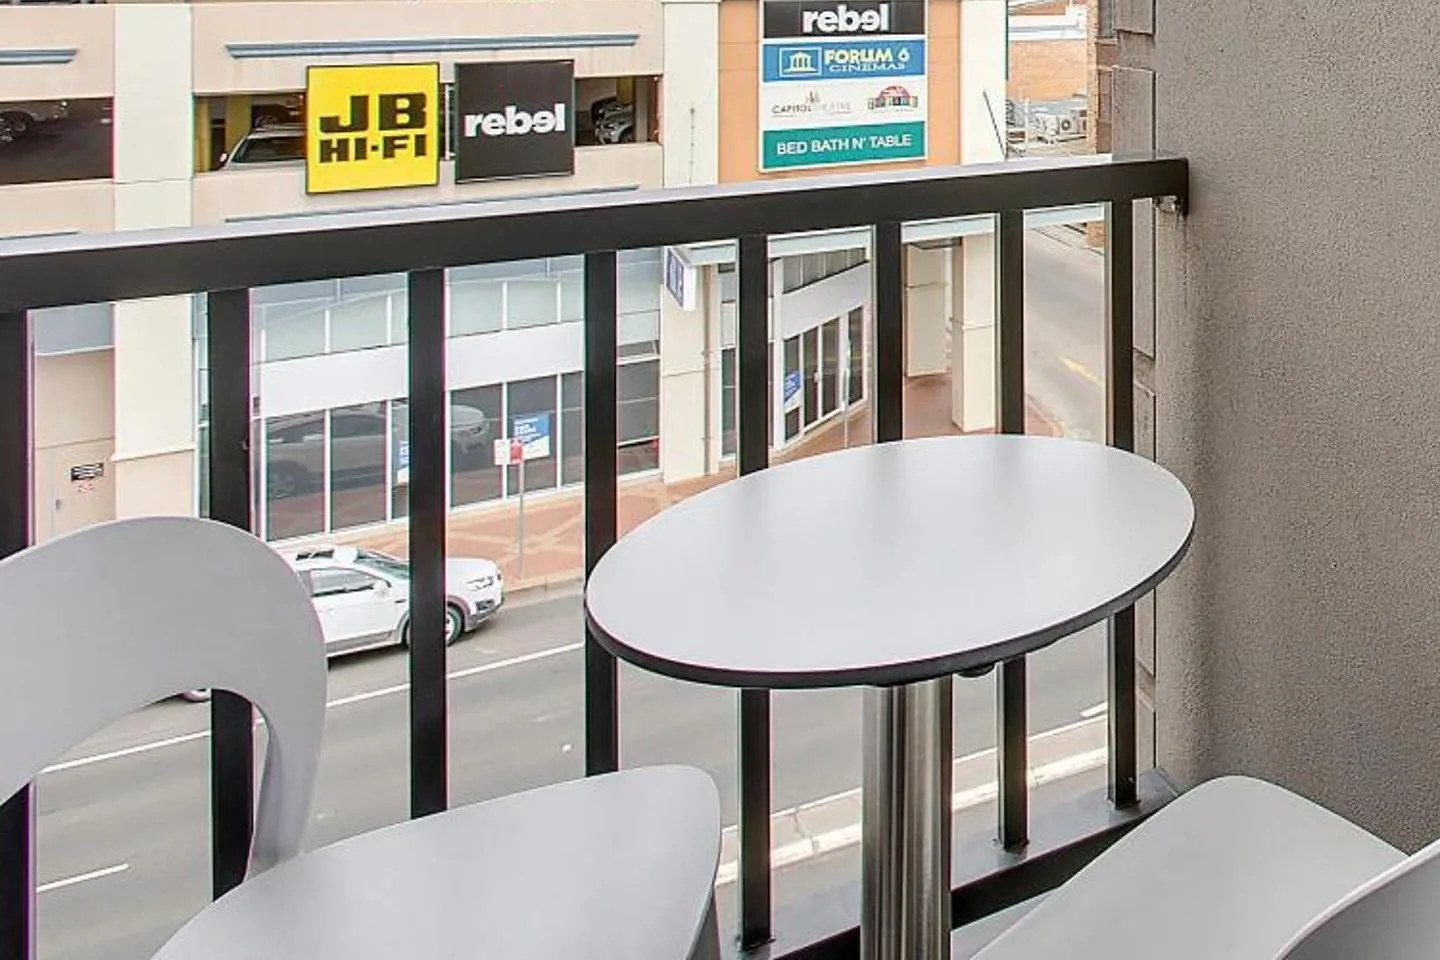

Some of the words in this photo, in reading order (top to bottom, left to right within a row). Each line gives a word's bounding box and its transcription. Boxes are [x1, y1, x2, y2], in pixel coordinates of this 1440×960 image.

[802, 3, 890, 33] rebel
[824, 48, 893, 65] FORUM
[898, 47, 910, 62] 6
[829, 62, 906, 73] CINEMAS
[319, 93, 426, 133] JB
[464, 103, 565, 137] rebel
[771, 103, 813, 114] CAPITOL
[319, 134, 426, 162] HI-FI
[777, 142, 808, 155] BED
[811, 138, 849, 153] BATH
[852, 136, 866, 150] N'
[869, 134, 912, 149] TABLE
